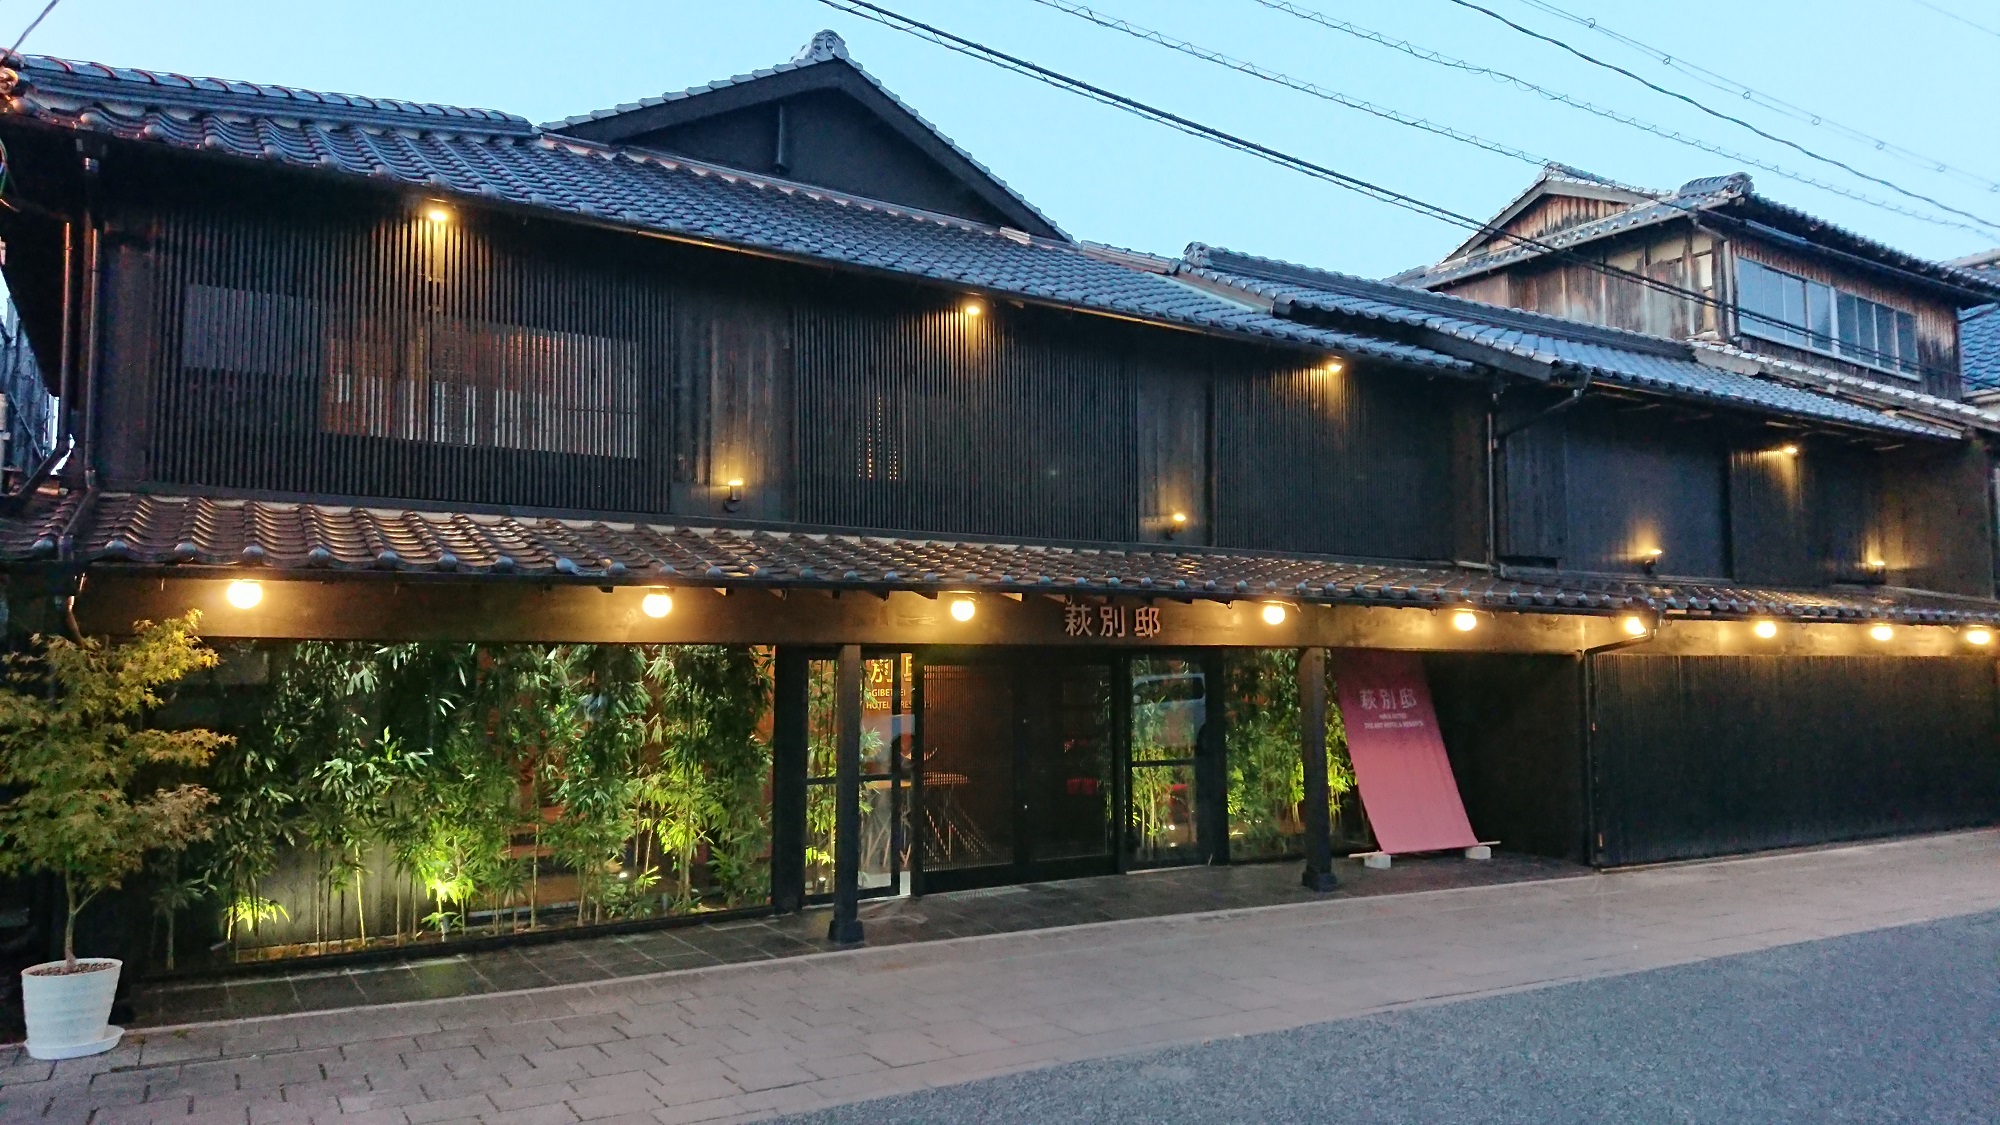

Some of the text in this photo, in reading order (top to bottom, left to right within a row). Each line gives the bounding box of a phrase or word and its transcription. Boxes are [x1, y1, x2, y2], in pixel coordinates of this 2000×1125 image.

[1064, 604, 1161, 638] 萩別邸
[1360, 688, 1417, 710] 萩別邸
